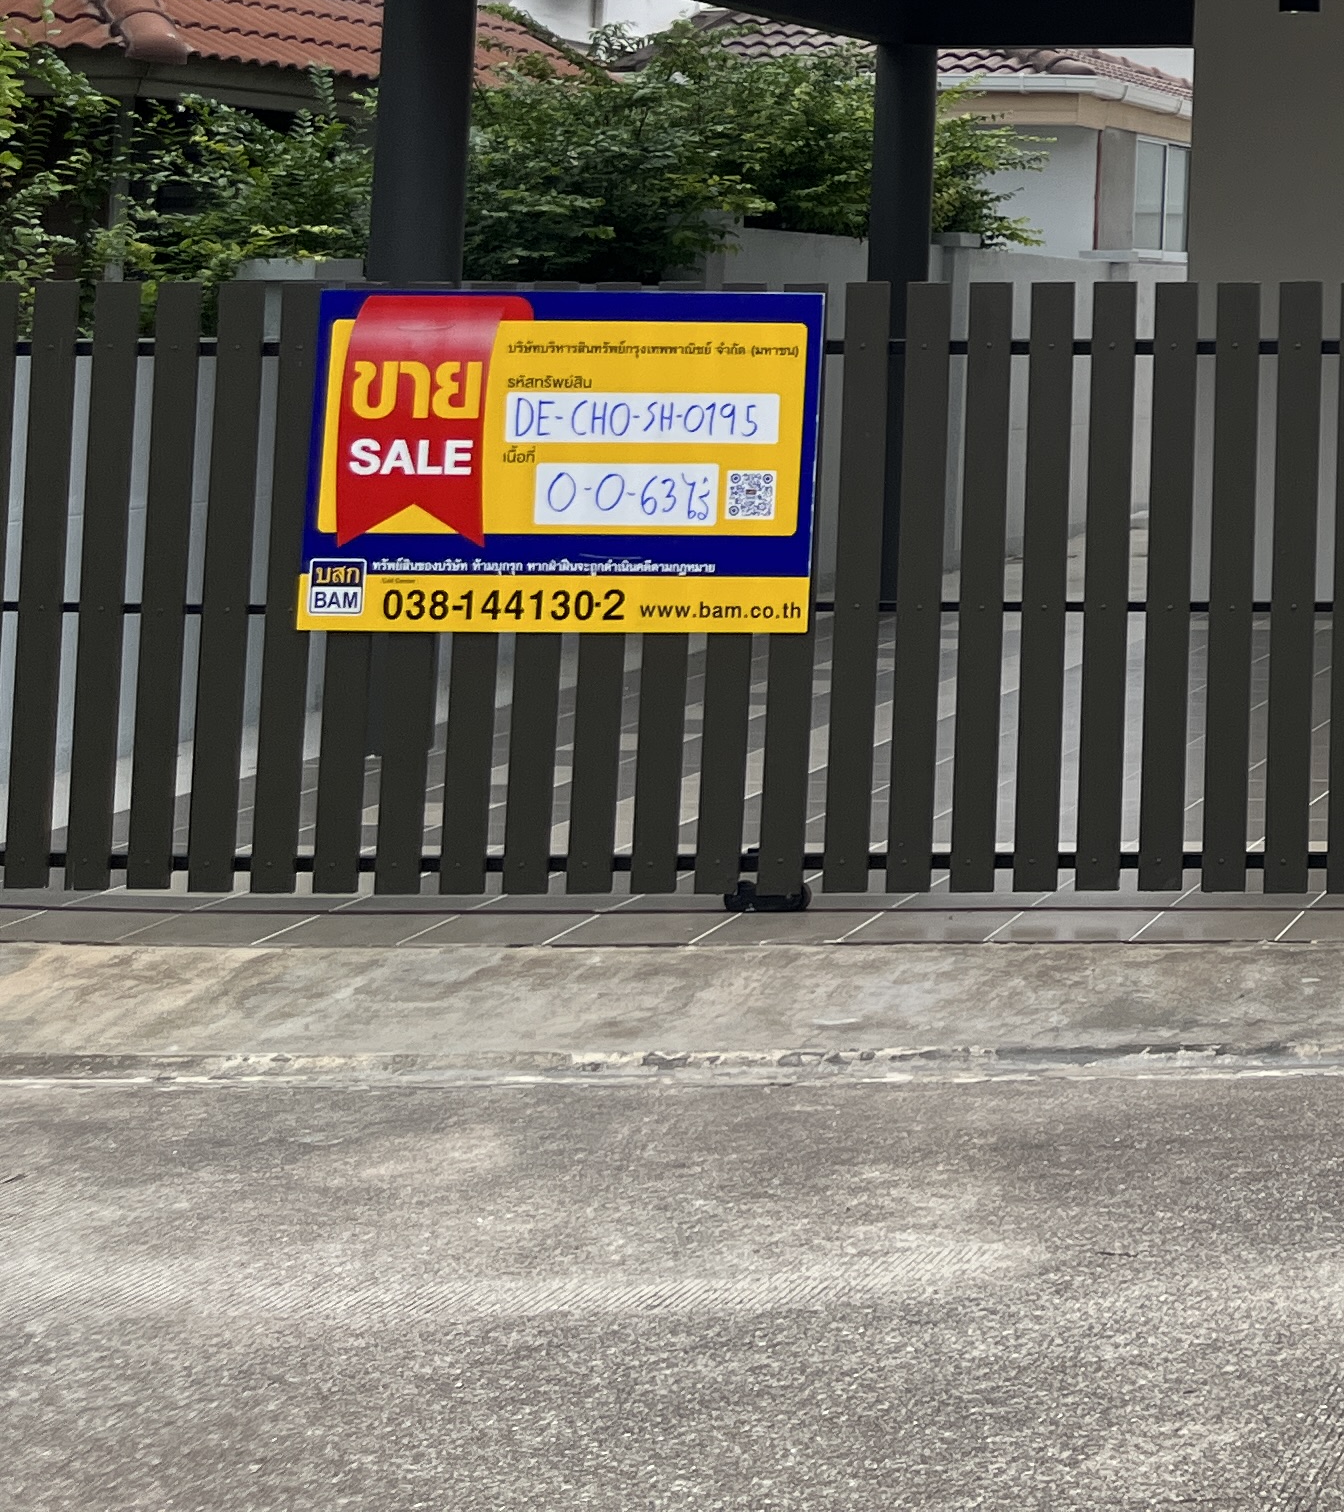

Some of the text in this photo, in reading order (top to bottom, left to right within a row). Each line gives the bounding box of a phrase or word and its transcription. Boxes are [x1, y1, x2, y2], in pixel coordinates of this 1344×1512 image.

[751, 345, 799, 358] (มหาชน)
[352, 360, 483, 420] ขาย
[507, 375, 592, 389] รหัสทรัพย์สิน
[349, 438, 474, 476] SALE
[503, 445, 536, 464] เนื้อที่
[315, 565, 360, 584] บสก
[314, 591, 358, 609] BAM
[383, 589, 802, 621] 038-144130-2 www.bam.co.th
